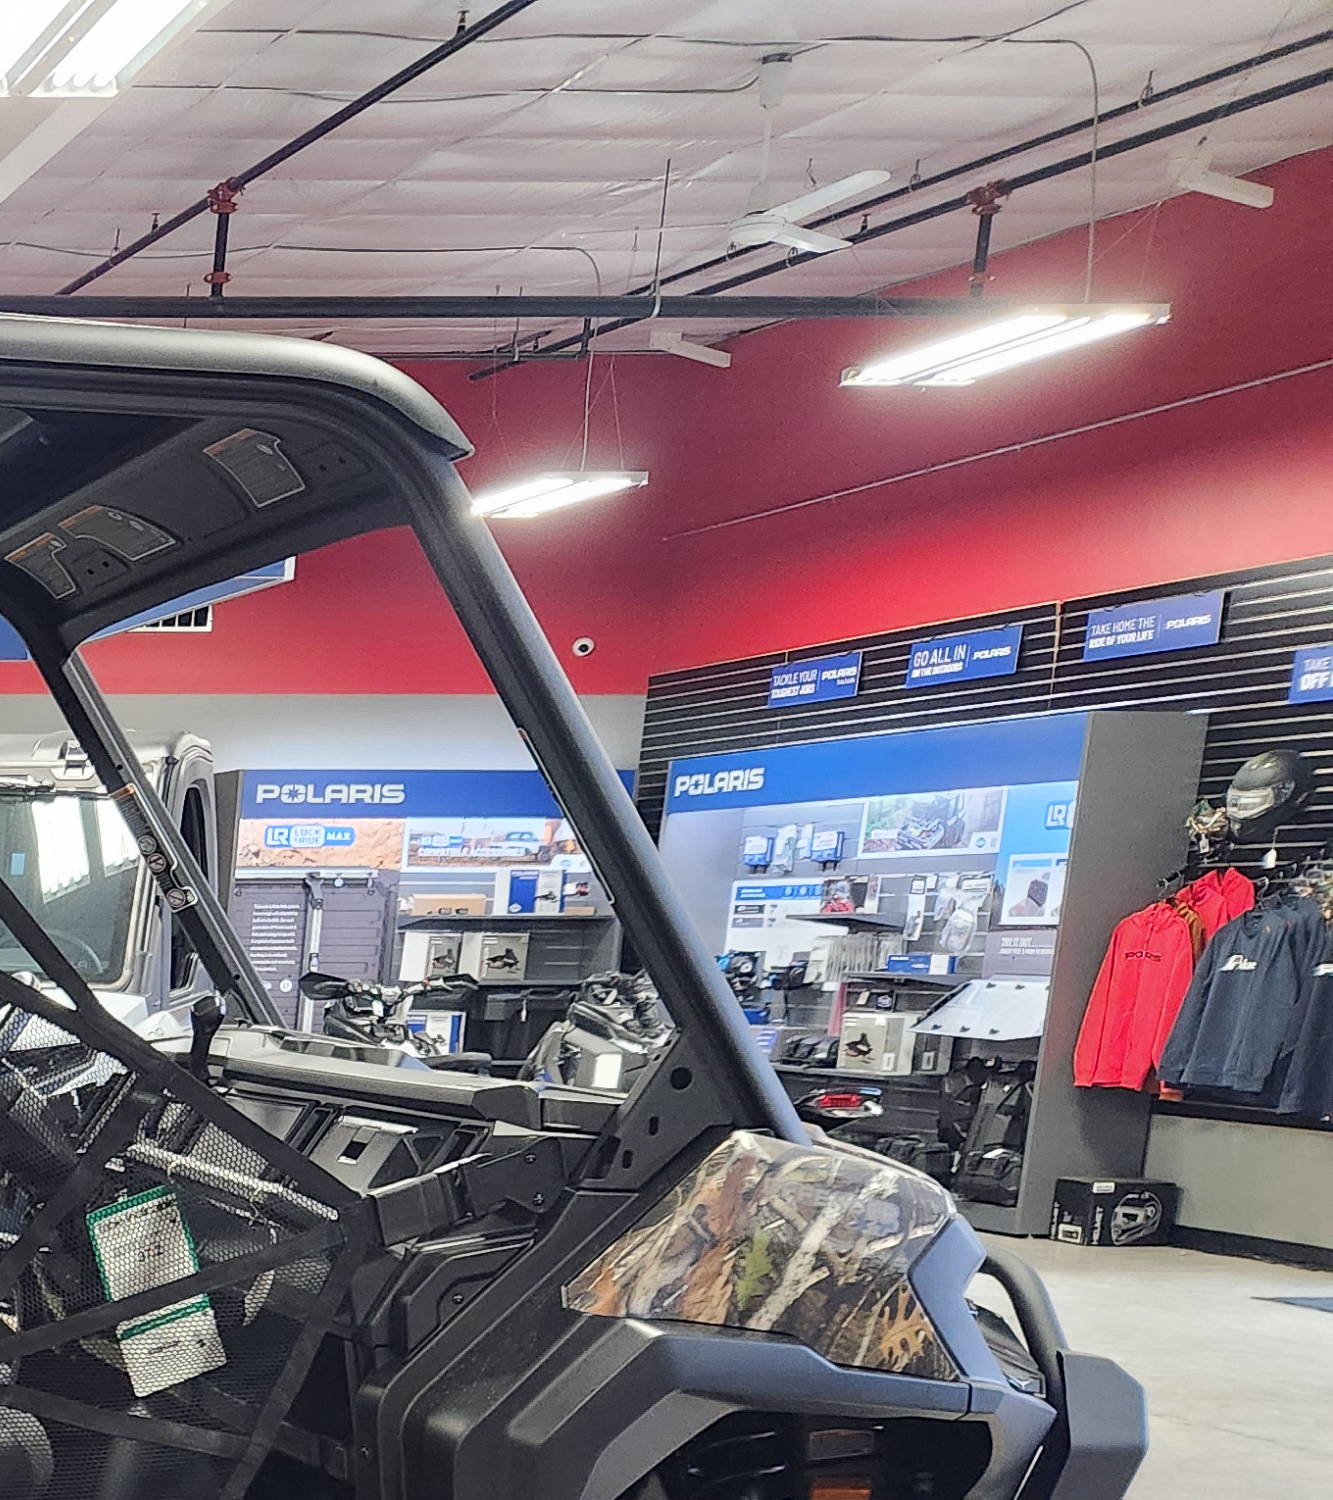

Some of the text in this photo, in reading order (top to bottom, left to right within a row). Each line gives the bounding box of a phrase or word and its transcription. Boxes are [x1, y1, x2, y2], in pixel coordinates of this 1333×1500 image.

[1091, 616, 1156, 636] TAKE HOME THE
[1165, 614, 1212, 629] POLARIS
[1089, 629, 1154, 648] RIDE OF YOUR LIFE
[914, 643, 967, 667] GO ALL IN
[972, 646, 1012, 660] POLARIS
[773, 669, 818, 687] TACKLE YOUR
[821, 666, 857, 681] POLARIS
[1299, 671, 1331, 691] OFF
[771, 683, 816, 699] TOUGHEST JOBS
[674, 767, 765, 797] POLARIS
[256, 784, 406, 804] POLARIS
[326, 831, 351, 841] MAX
